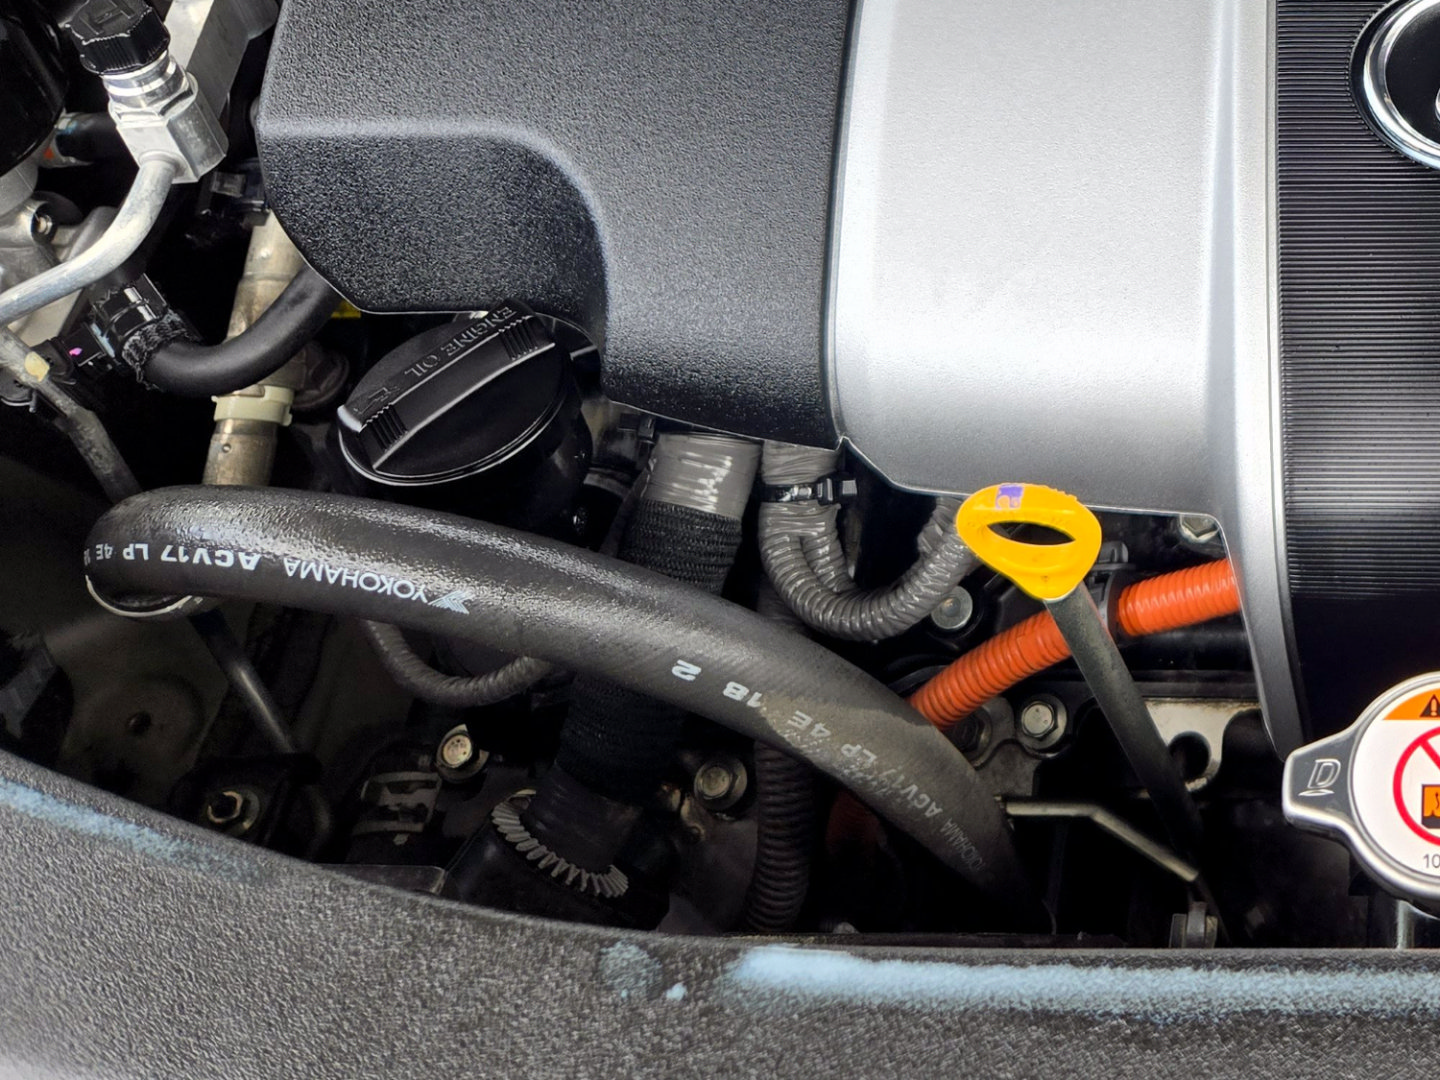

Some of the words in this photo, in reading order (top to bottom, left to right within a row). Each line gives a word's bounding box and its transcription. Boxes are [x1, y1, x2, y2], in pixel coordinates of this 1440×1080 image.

[440, 305, 517, 357] ENGINE
[404, 353, 442, 378] OIL
[95, 542, 113, 561] 4E
[122, 543, 150, 561] LP
[160, 542, 264, 571] ACV17
[283, 556, 429, 604] YOKOHAMA
[671, 659, 702, 682] 2
[786, 710, 831, 739] 4E
